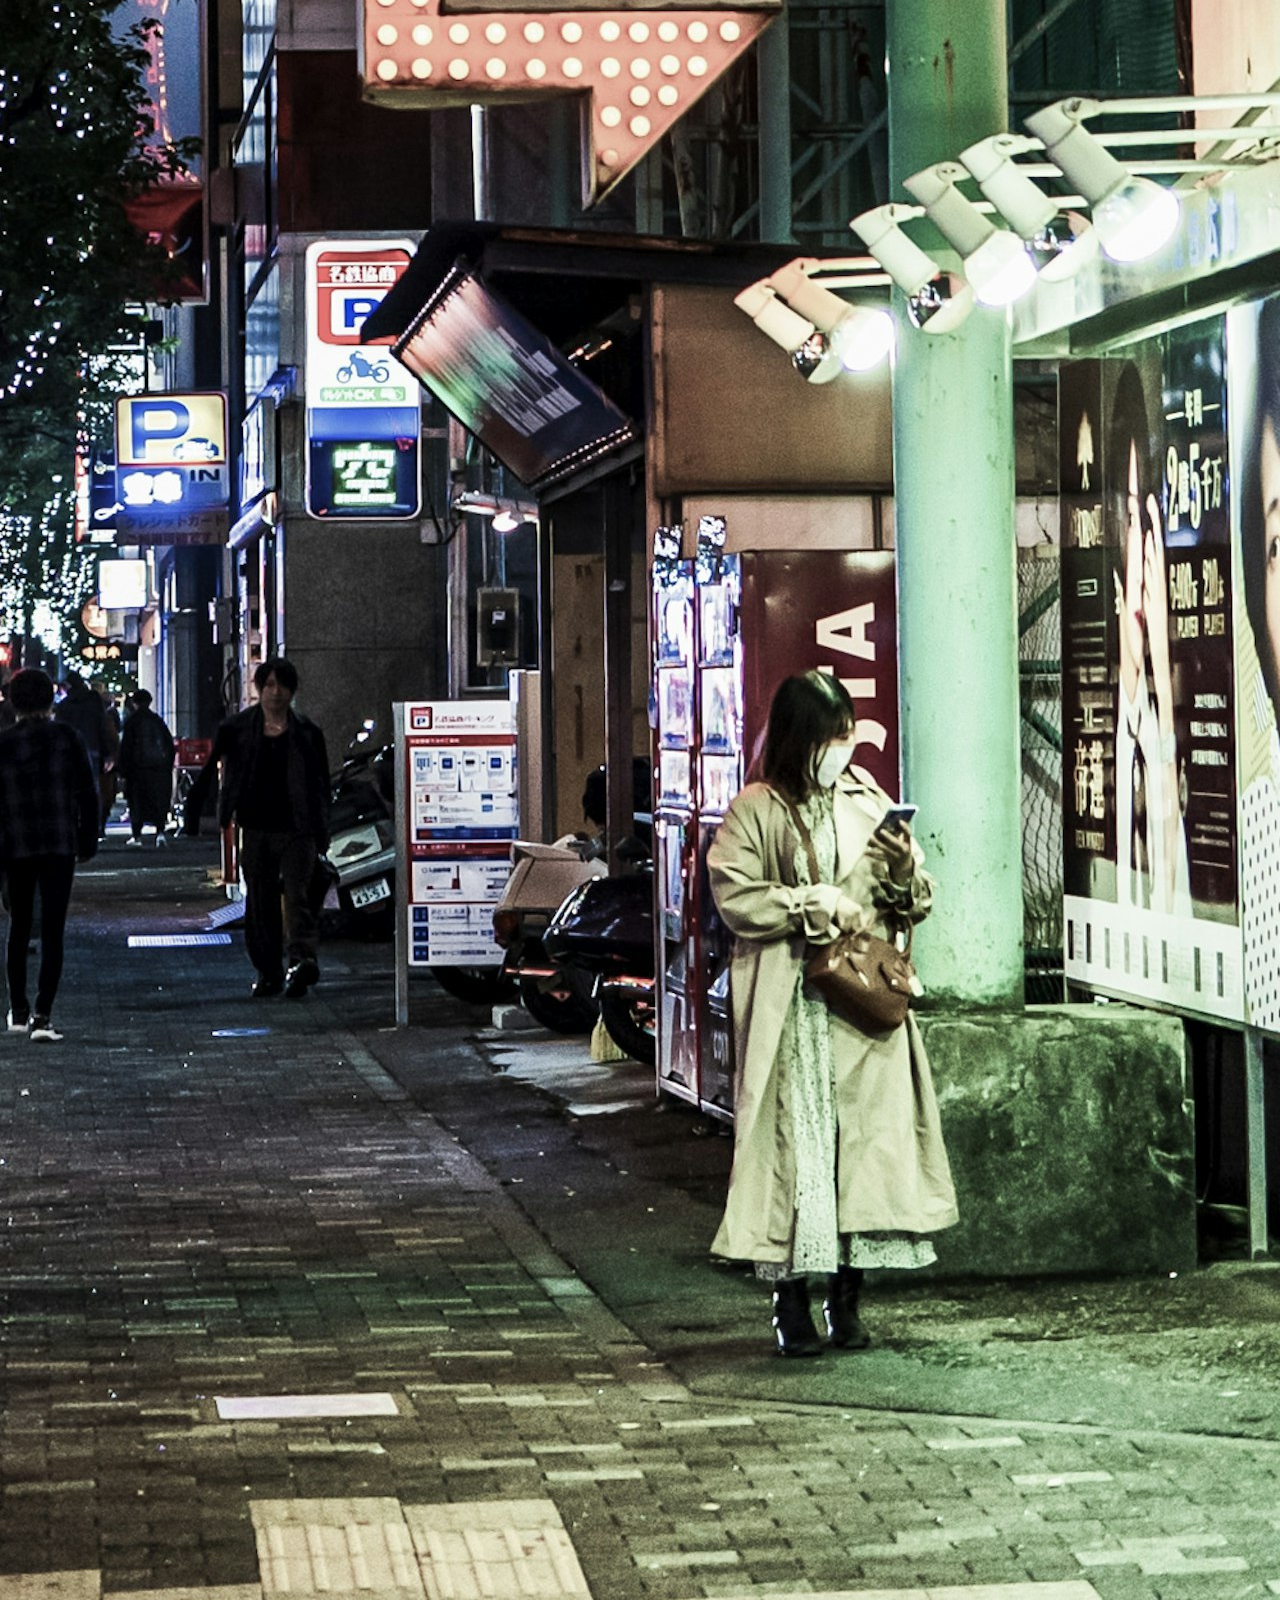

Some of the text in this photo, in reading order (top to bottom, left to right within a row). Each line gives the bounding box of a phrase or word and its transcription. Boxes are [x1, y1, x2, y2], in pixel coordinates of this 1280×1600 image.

[128, 401, 189, 460] P
[189, 470, 222, 483] IN
[333, 443, 397, 505] 空
